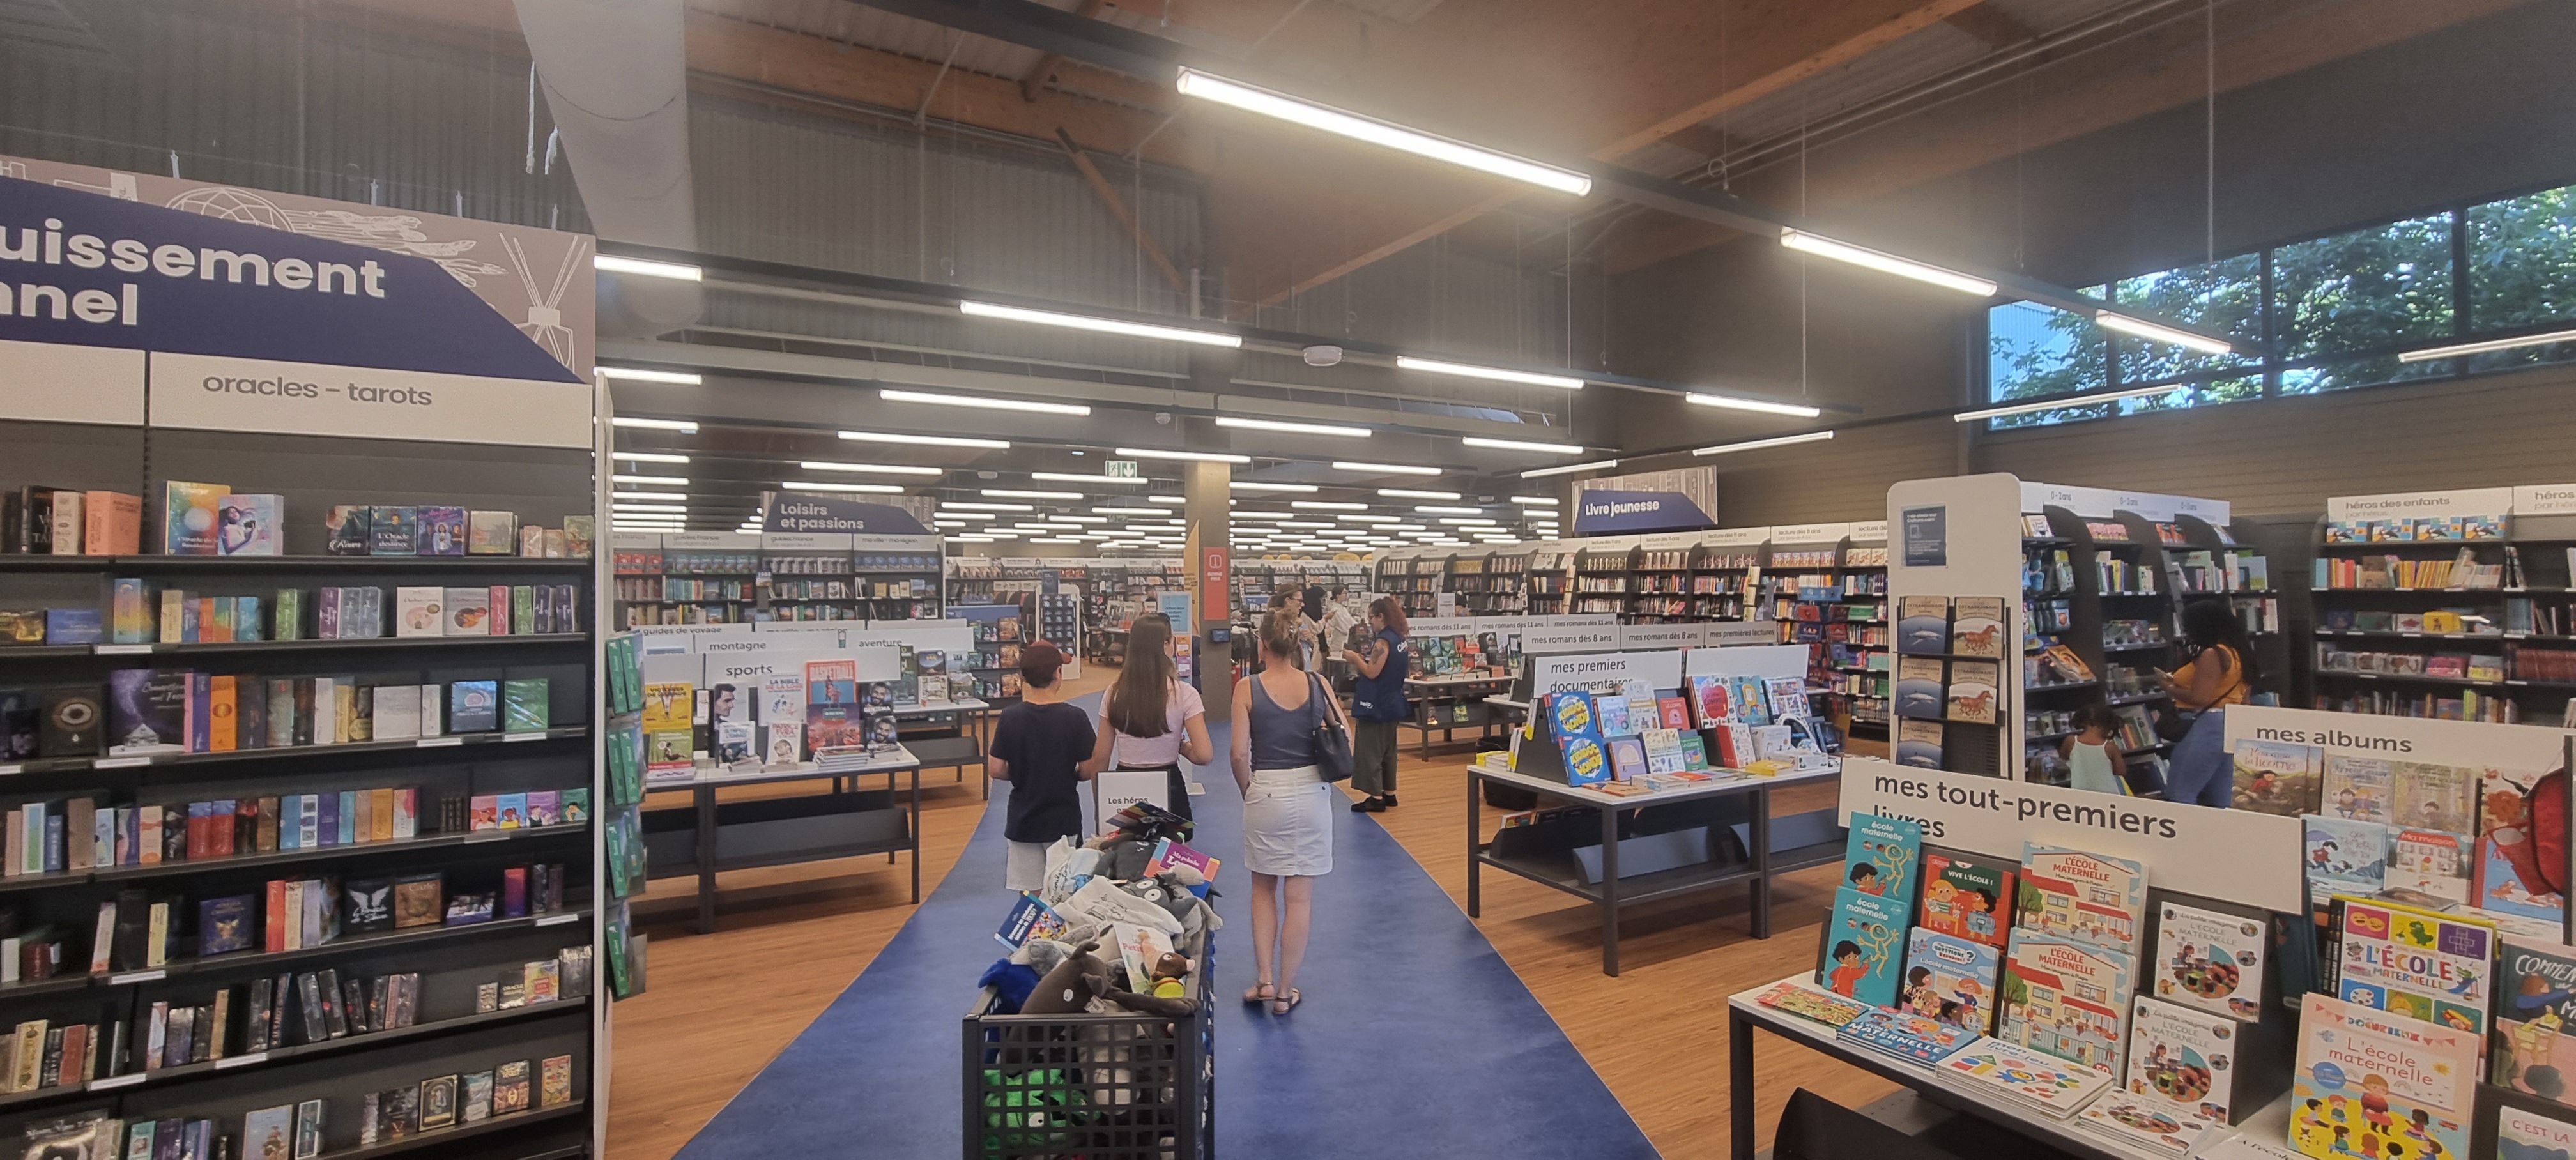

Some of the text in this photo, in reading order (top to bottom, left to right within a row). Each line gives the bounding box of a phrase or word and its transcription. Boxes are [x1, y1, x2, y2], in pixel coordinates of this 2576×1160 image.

[0, 281, 138, 326] nel
[203, 376, 319, 399] oracles
[347, 382, 433, 406] tarots
[2535, 490, 2575, 500] héros
[781, 503, 827, 515] Loisirs
[1585, 500, 1660, 518] Livre jeunesse
[2345, 497, 2450, 510] héros des enfants
[780, 517, 864, 531] et passions
[643, 627, 675, 636] guides
[1548, 635, 1577, 643] romans
[1578, 633, 1592, 643] dès
[1593, 634, 1598, 642] 8
[1644, 632, 1668, 641] romans
[1669, 631, 1681, 639] dès
[1722, 628, 1752, 639] premières
[1752, 628, 1775, 637] lectures
[709, 641, 767, 651] montagne
[859, 639, 903, 648] aventure
[726, 664, 773, 678] sports
[1551, 658, 1626, 675] mes premiers
[2257, 727, 2412, 752] mes albums
[1874, 775, 2177, 839] mes tout-premiers
[1871, 820, 1894, 832] école
[1861, 827, 1903, 842] maternelle
[2402, 832, 2457, 846] Ma maison
[2065, 855, 2099, 871] L'ÉCOLE
[1948, 870, 1963, 880] VIVE
[1964, 873, 1989, 885] L'ÉCOLE
[2053, 864, 2110, 882] MATERNELLE
[1856, 897, 1880, 910] école
[1846, 903, 1889, 921] maternelle
[2178, 927, 2237, 946] MATERNELLE
[2050, 947, 2084, 963] L'ÉCOLE
[2366, 945, 2453, 981] L'ÉCOLE
[1920, 958, 1979, 979] L'école maternelle
[2038, 954, 2096, 976] MATERNELLE
[2373, 966, 2447, 991] MATERNELLE
[1848, 1022, 1944, 1054] MATERNELLE
[2150, 1026, 2209, 1048] MATERNELLE
[1989, 1041, 2028, 1054] mon
[2347, 1037, 2416, 1068] L'école
[2329, 1049, 2433, 1086] maternelle
[2512, 1119, 2570, 1144] C'EST LA
